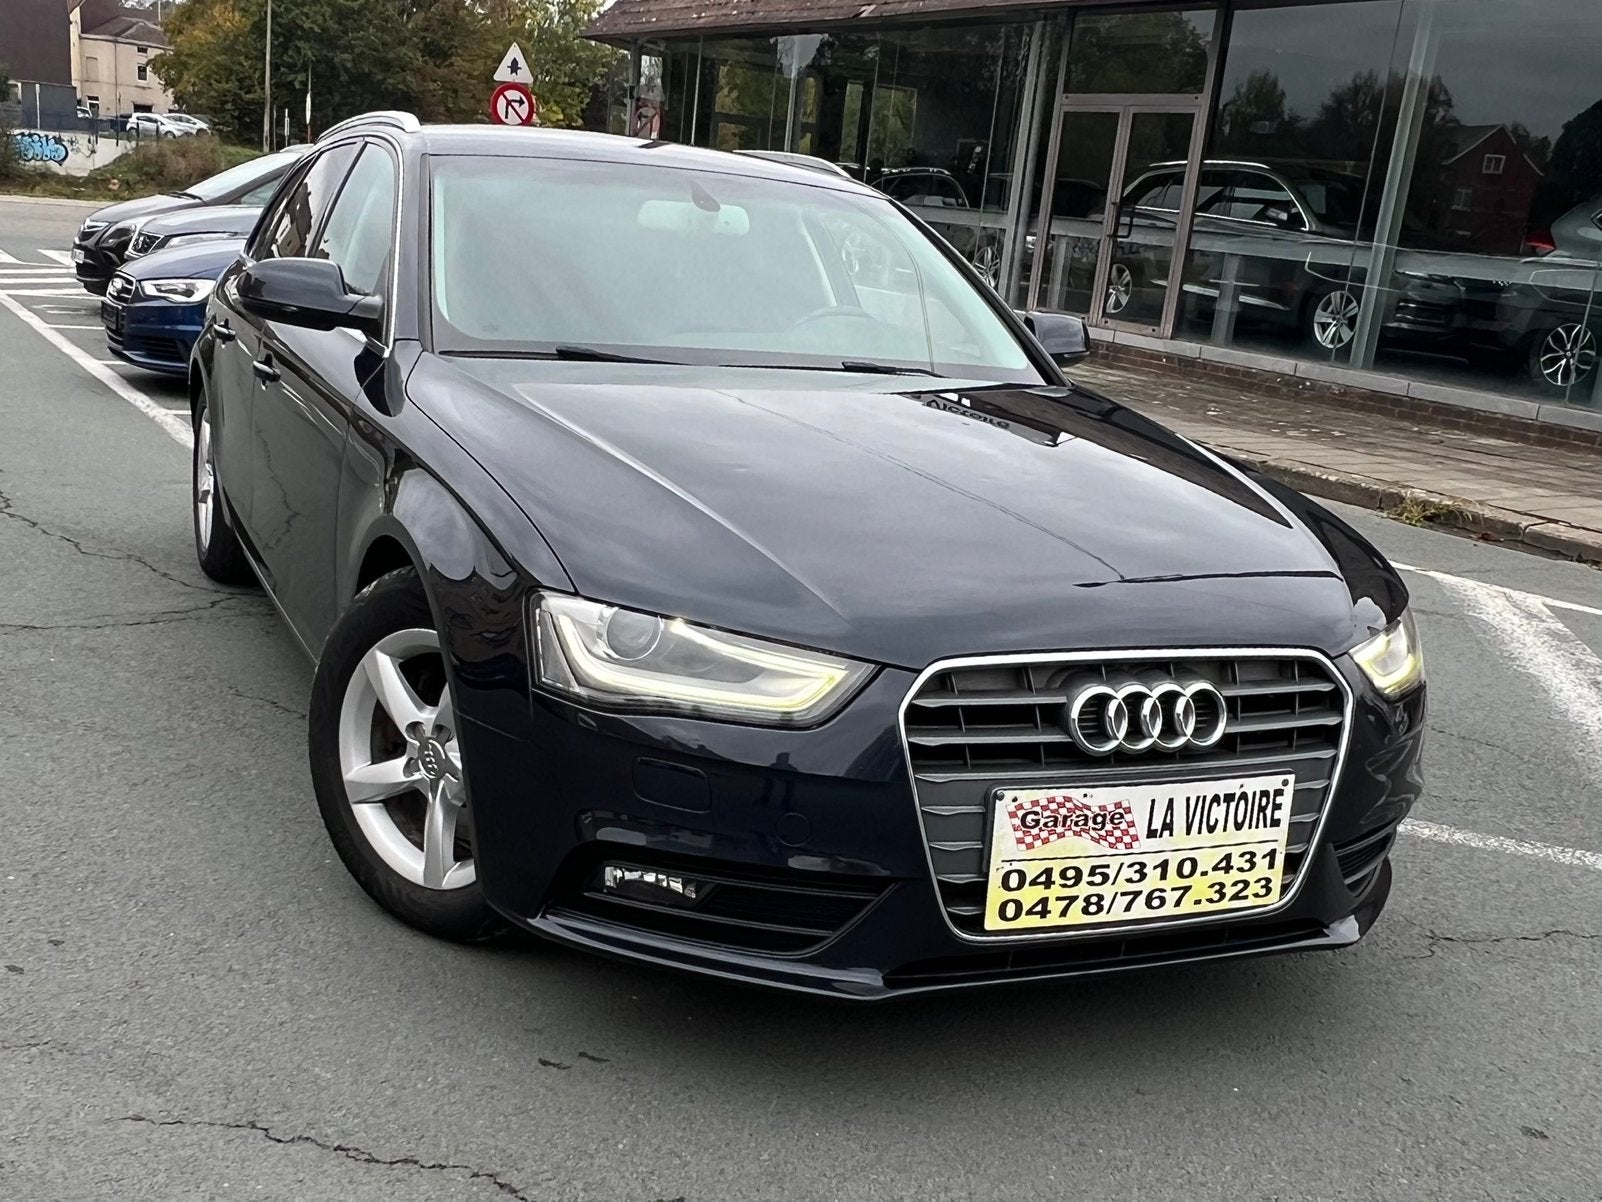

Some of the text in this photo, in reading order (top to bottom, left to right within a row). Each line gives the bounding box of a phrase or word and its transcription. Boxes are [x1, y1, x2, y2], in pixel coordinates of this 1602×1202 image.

[1019, 807, 1125, 831] Garage
[1145, 788, 1285, 839] LA VICTOIRE
[1001, 848, 1278, 892] 0495/310.431
[997, 877, 1273, 922] 0478/767.323
